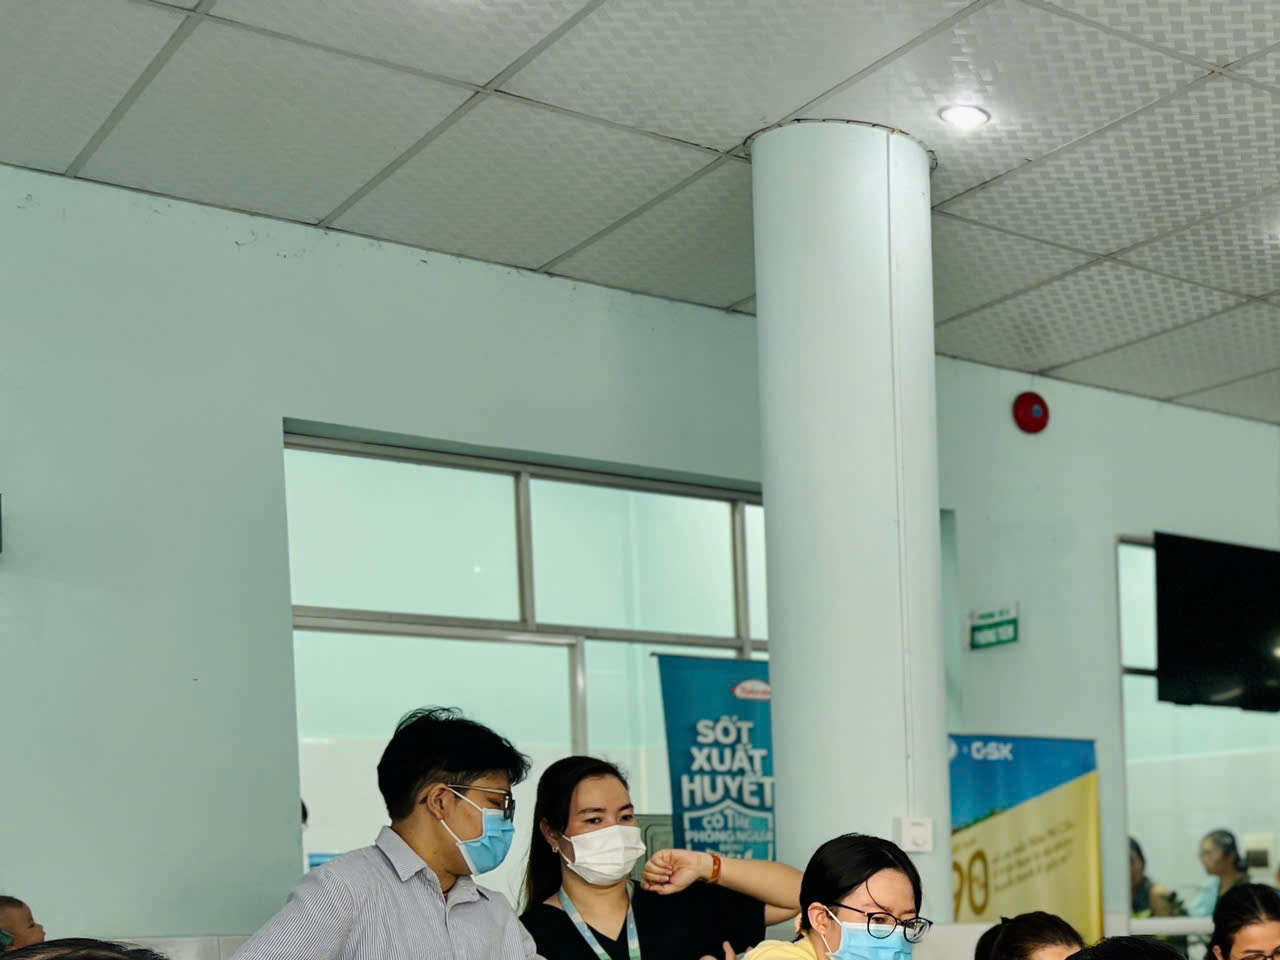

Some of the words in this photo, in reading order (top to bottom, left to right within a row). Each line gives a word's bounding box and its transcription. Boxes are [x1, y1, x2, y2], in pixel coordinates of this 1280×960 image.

[696, 715, 754, 743] SỐT
[690, 743, 768, 772] XUẤT
[970, 741, 1013, 760] GSK
[681, 771, 775, 808] HUYẾT
